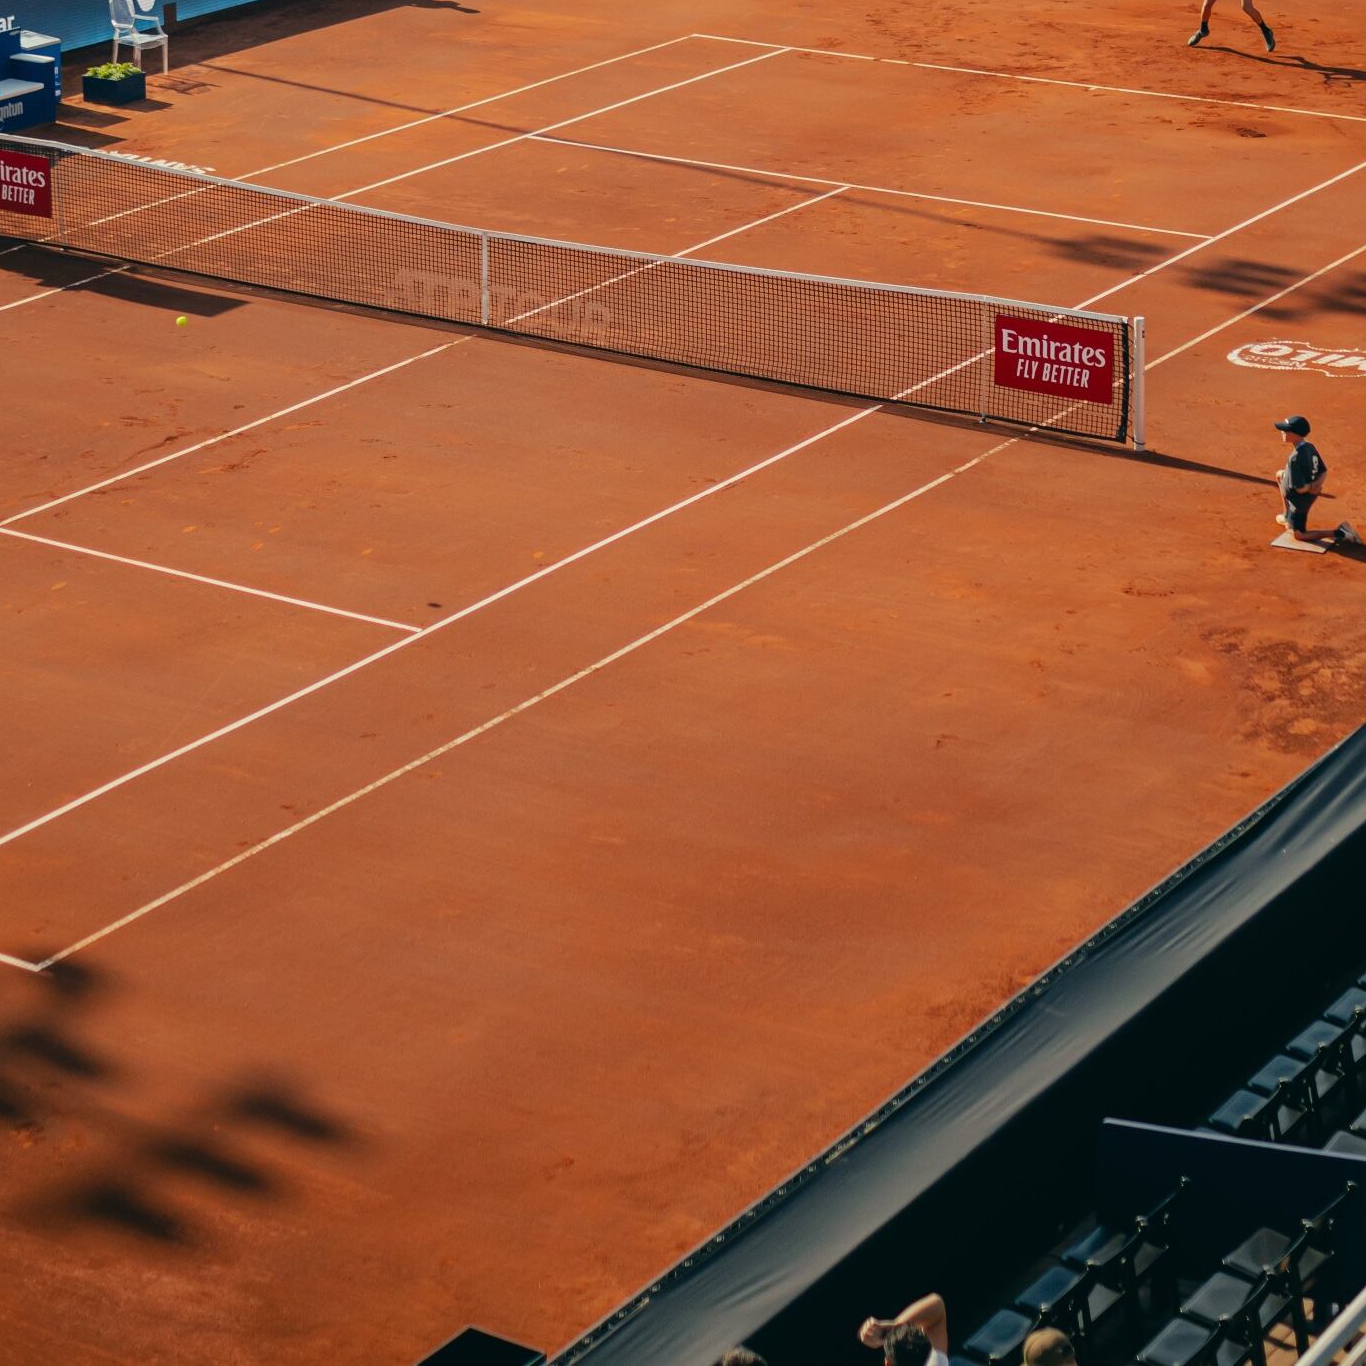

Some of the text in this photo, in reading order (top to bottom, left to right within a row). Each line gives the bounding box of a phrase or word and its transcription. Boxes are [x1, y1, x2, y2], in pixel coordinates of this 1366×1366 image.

[1, 183, 35, 205] BETTER
[1001, 328, 1107, 368] Emirates
[1016, 358, 1090, 389] FLY BETTER
